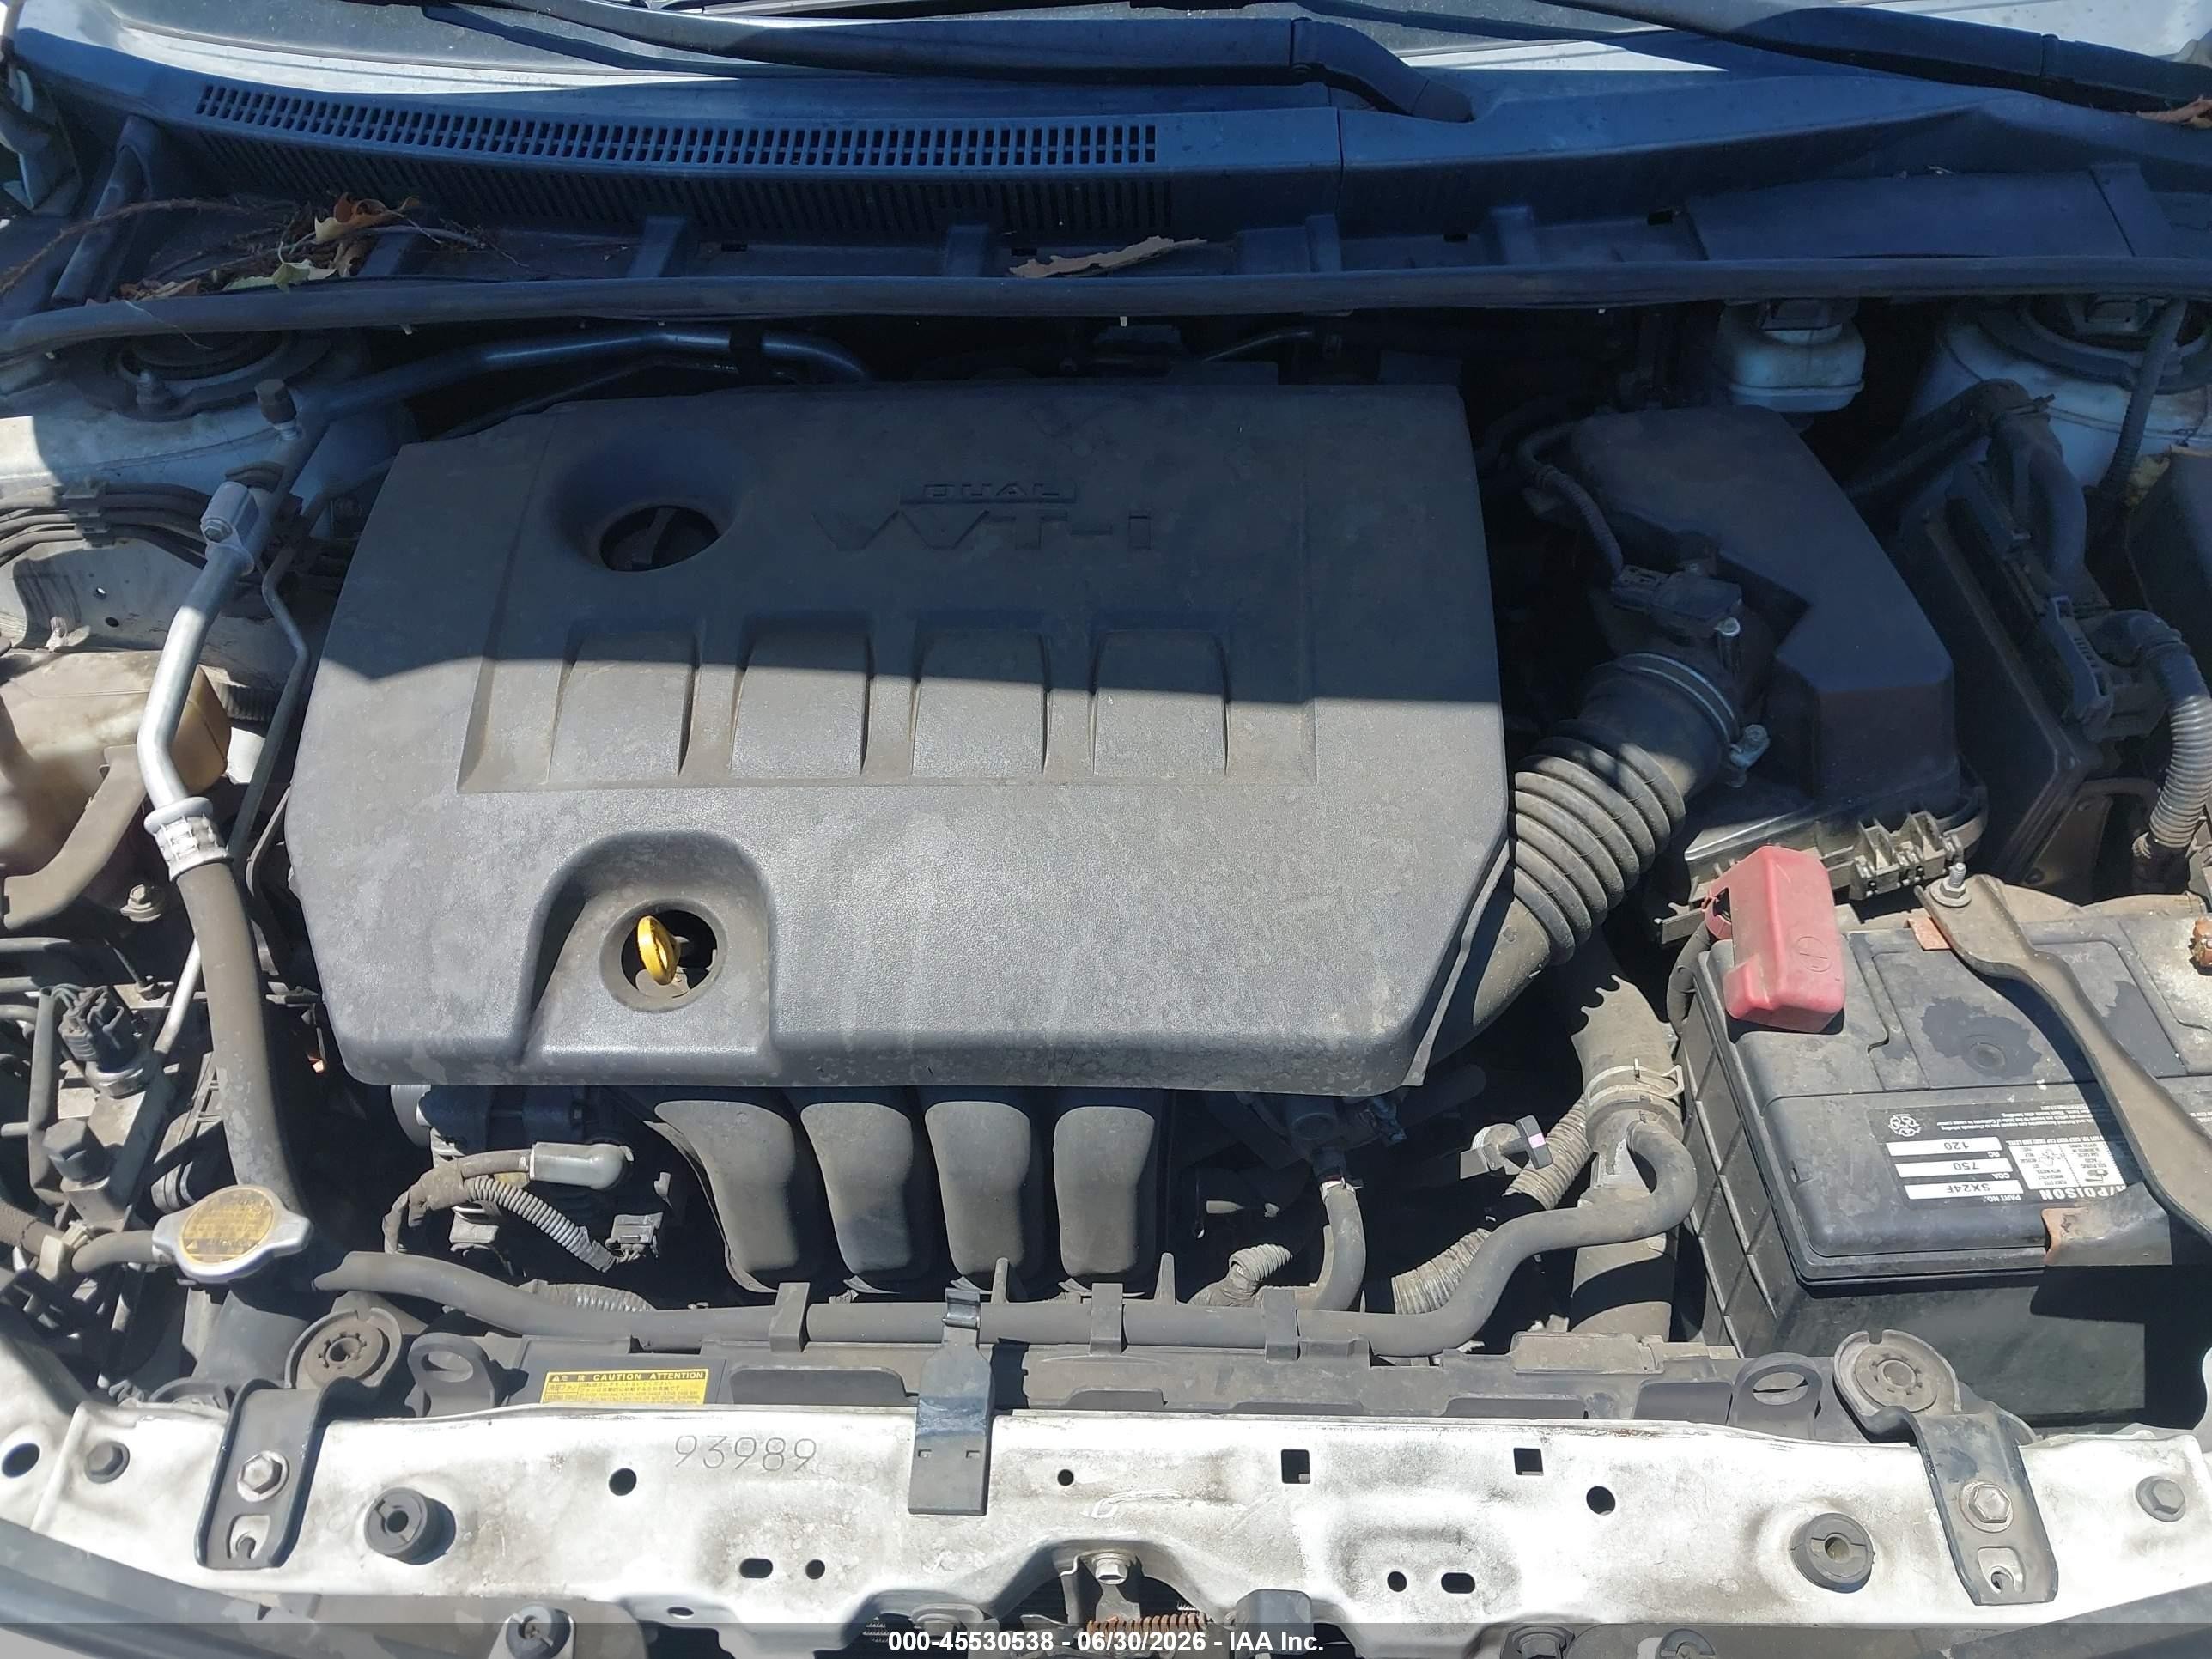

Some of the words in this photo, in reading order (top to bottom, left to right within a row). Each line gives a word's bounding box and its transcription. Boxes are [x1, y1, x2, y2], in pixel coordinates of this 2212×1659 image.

[923, 483, 1060, 497] DUAL
[1943, 1141, 1969, 1150] 120
[1953, 1162, 1979, 1170] 750
[1946, 1183, 1990, 1194] SX24F
[593, 1373, 641, 1382] CAUTION
[649, 1371, 703, 1381] ATTENTION
[675, 1435, 817, 1472] 93989
